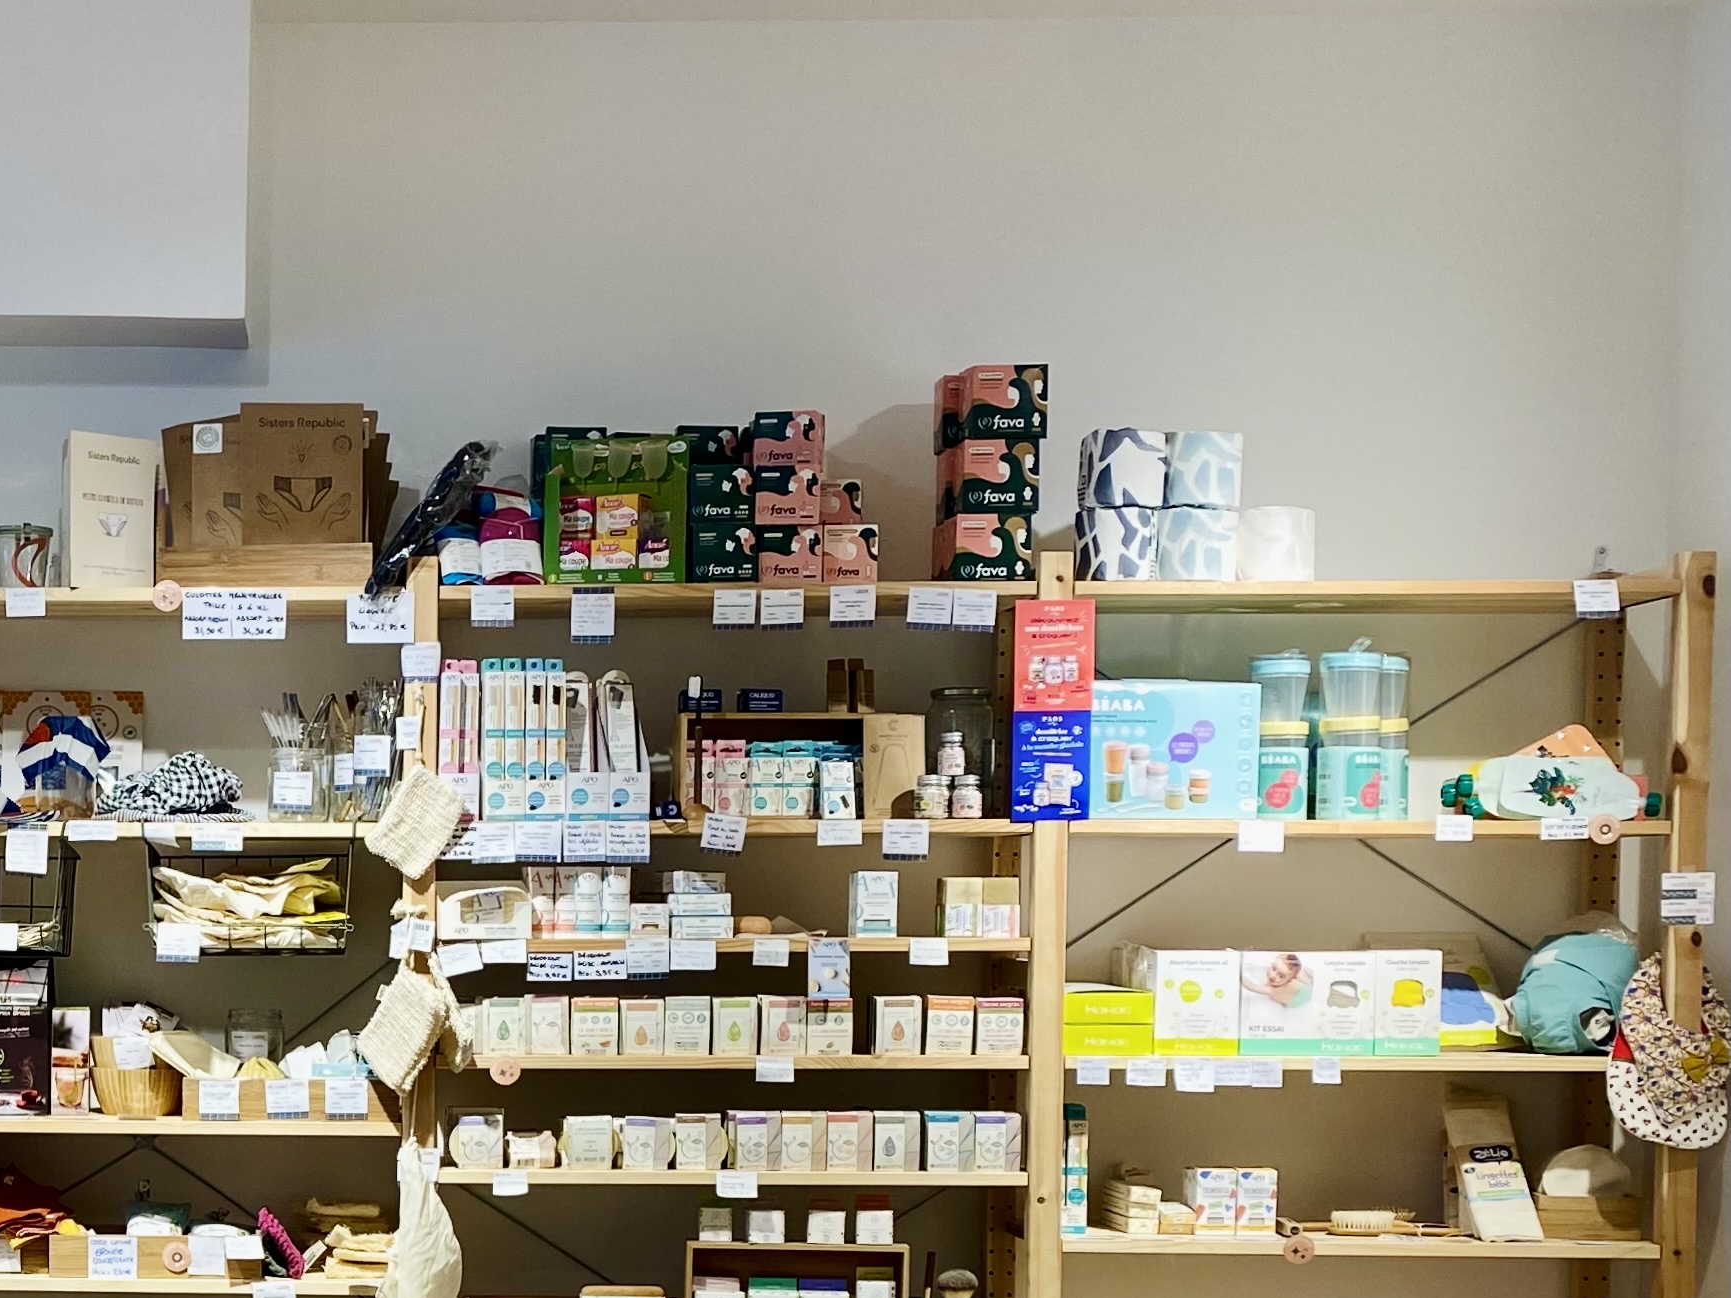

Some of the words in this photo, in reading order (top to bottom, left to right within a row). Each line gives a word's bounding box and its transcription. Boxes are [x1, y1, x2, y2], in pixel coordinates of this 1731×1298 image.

[258, 416, 295, 428] Sisters
[297, 416, 346, 430] Republic
[994, 415, 1025, 429] fava
[87, 451, 111, 462] Sisters
[112, 454, 141, 465] Republic
[768, 450, 793, 462] fava
[983, 489, 1016, 503] fava
[619, 512, 635, 521] coupe
[704, 504, 731, 517] fava
[769, 504, 796, 517] fava
[573, 515, 590, 523] coupe
[568, 558, 586, 566] coupe
[615, 557, 632, 565] coupe
[708, 564, 735, 576] fava
[773, 563, 799, 576] fava
[836, 565, 860, 577] fava
[976, 562, 1008, 578] fava
[185, 591, 222, 599] CULOTTES
[531, 673, 544, 681] APO
[1092, 696, 1145, 712] BÉABA
[1261, 752, 1296, 765] BÉABA
[1476, 1171, 1518, 1180] Lingettes
[1489, 1180, 1511, 1188] bébé
